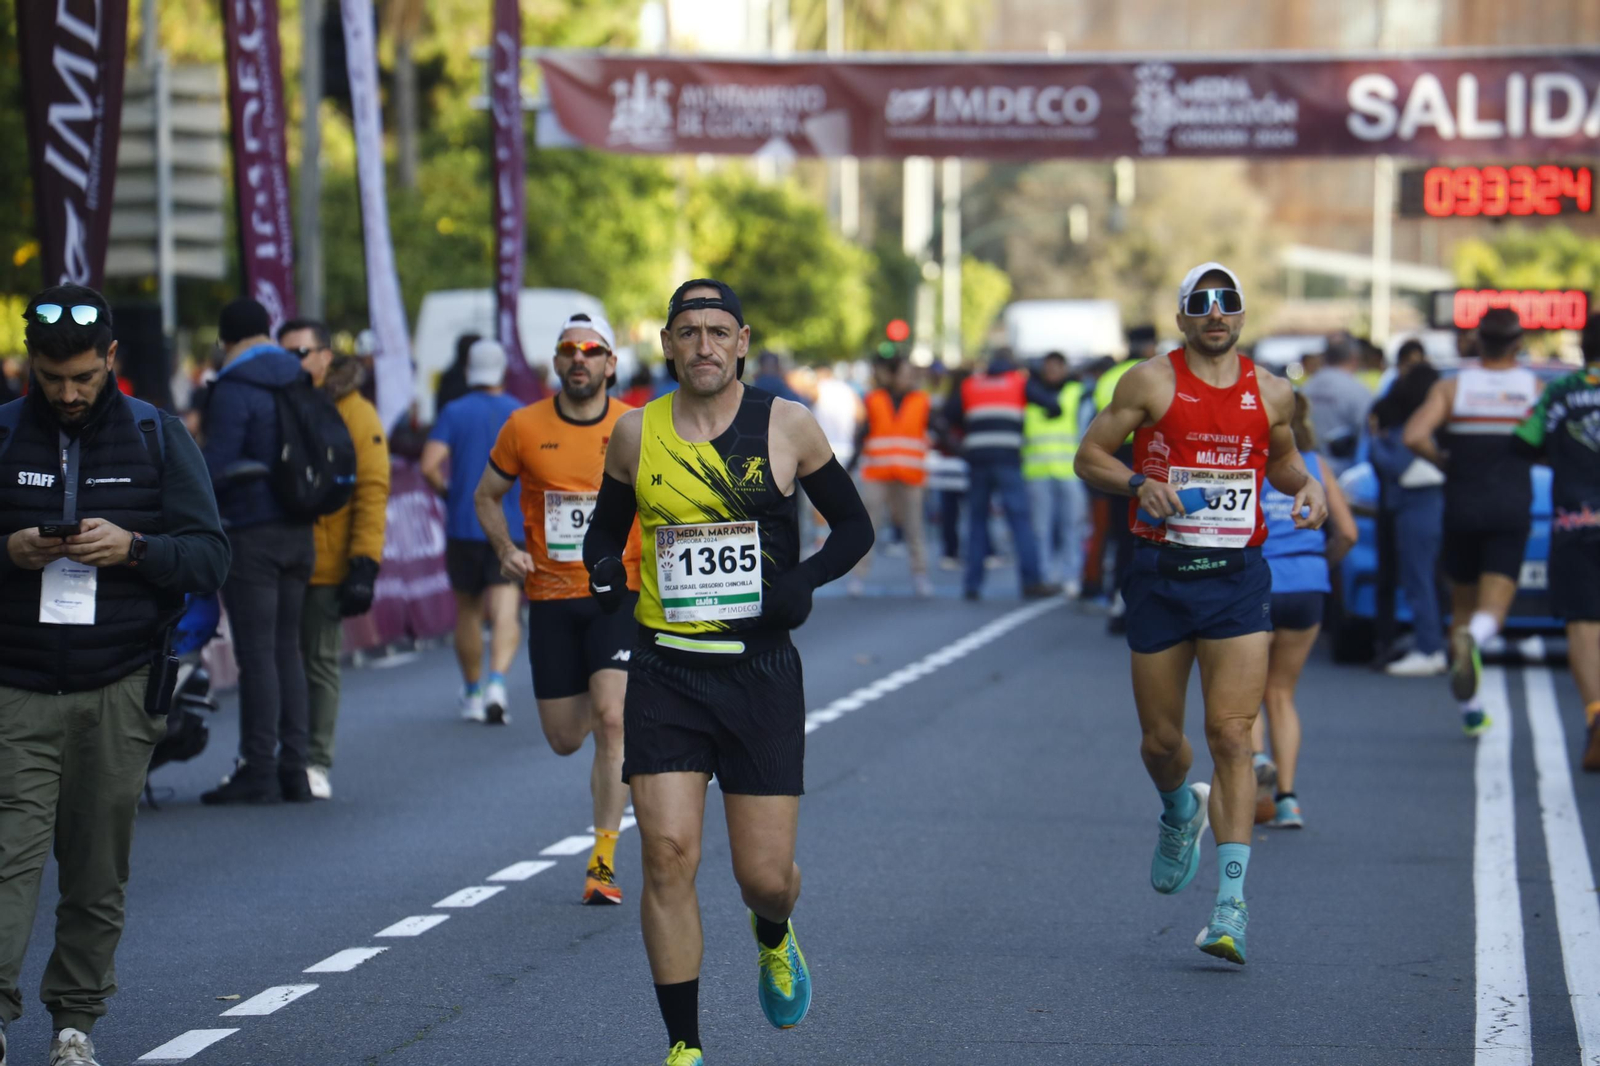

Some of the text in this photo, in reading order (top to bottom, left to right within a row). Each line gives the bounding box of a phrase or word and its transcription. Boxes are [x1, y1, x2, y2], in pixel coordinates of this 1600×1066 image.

[934, 84, 1101, 126] IMDECO
[1346, 72, 1600, 140] SALID
[1198, 433, 1239, 444] GENERALI
[1196, 448, 1238, 467] MÁLAGA
[17, 471, 55, 488] STAFF
[656, 524, 755, 547] 38 MEDIA MARATÓN
[678, 544, 757, 577] 1365
[698, 581, 724, 589] GREGORIO
[727, 604, 758, 613] IMDECO
